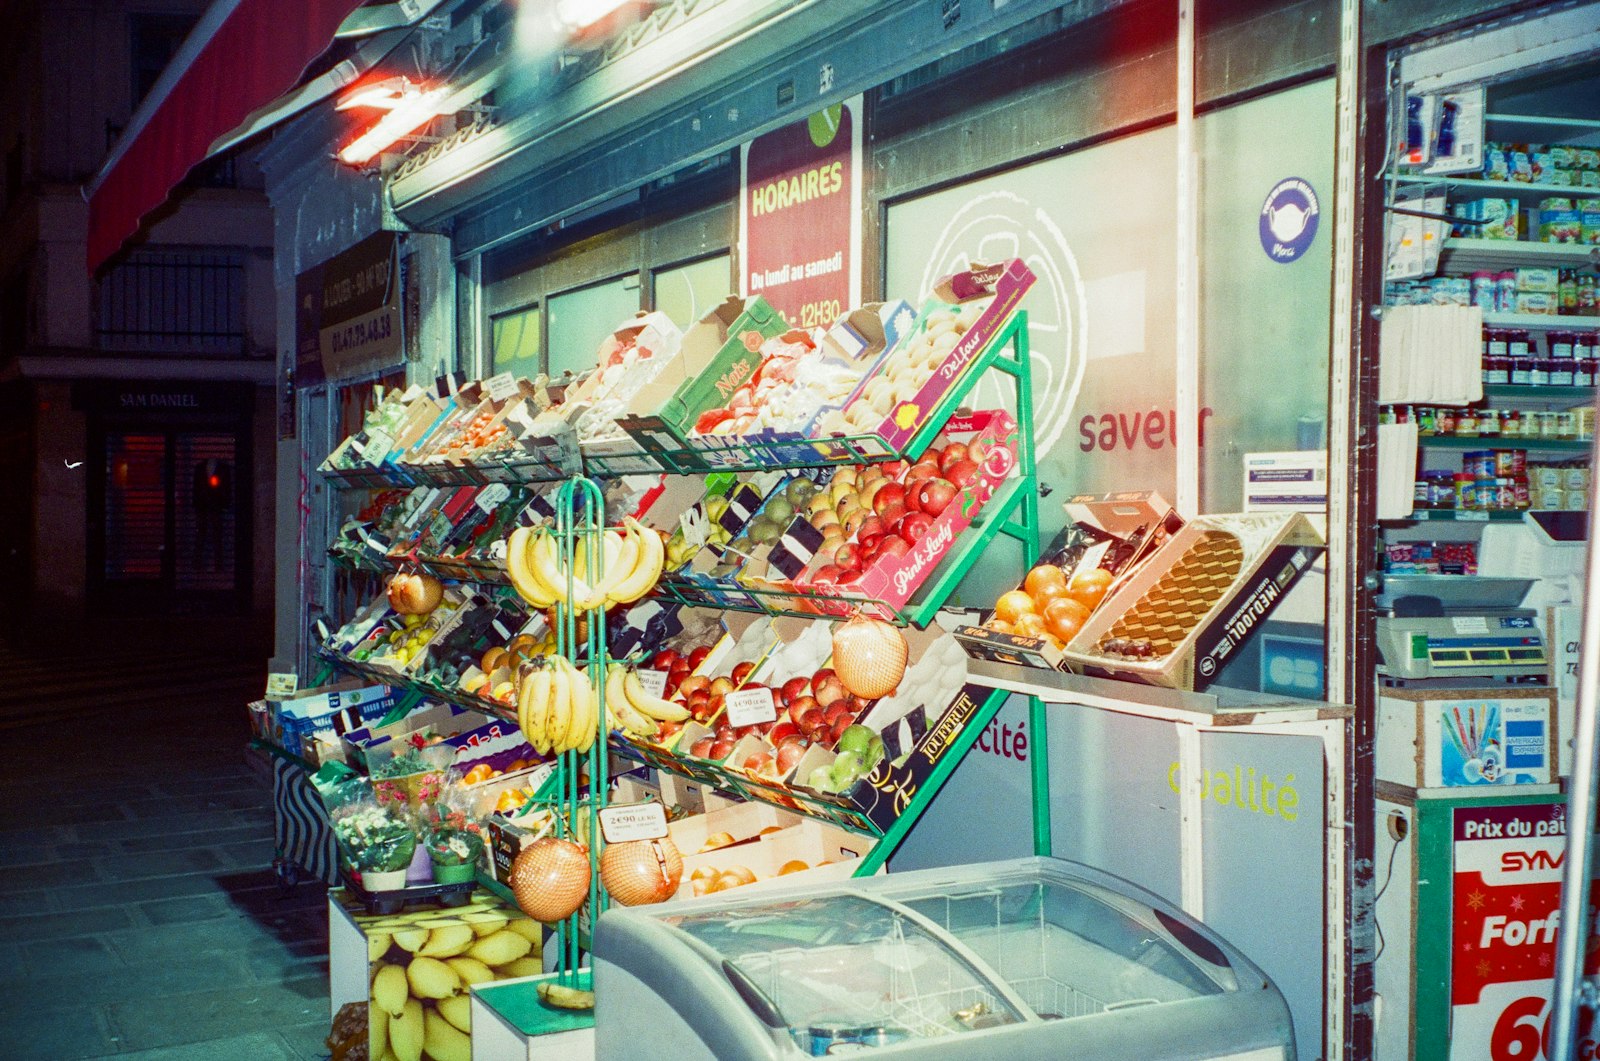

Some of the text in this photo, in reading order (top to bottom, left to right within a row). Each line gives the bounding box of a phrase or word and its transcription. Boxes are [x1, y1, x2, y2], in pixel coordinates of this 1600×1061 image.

[753, 162, 842, 217] HORAIRES
[752, 251, 842, 290] Du lundi au samedi
[800, 300, 840, 328] 12H30
[714, 358, 751, 400] Noix
[150, 393, 199, 408] DANIEL
[894, 519, 954, 596] Pink Lady
[1230, 586, 1278, 639] MEDJOOL
[919, 692, 977, 765] JOUFFRUIT
[1465, 820, 1503, 838] Prix
[1506, 818, 1532, 838] du
